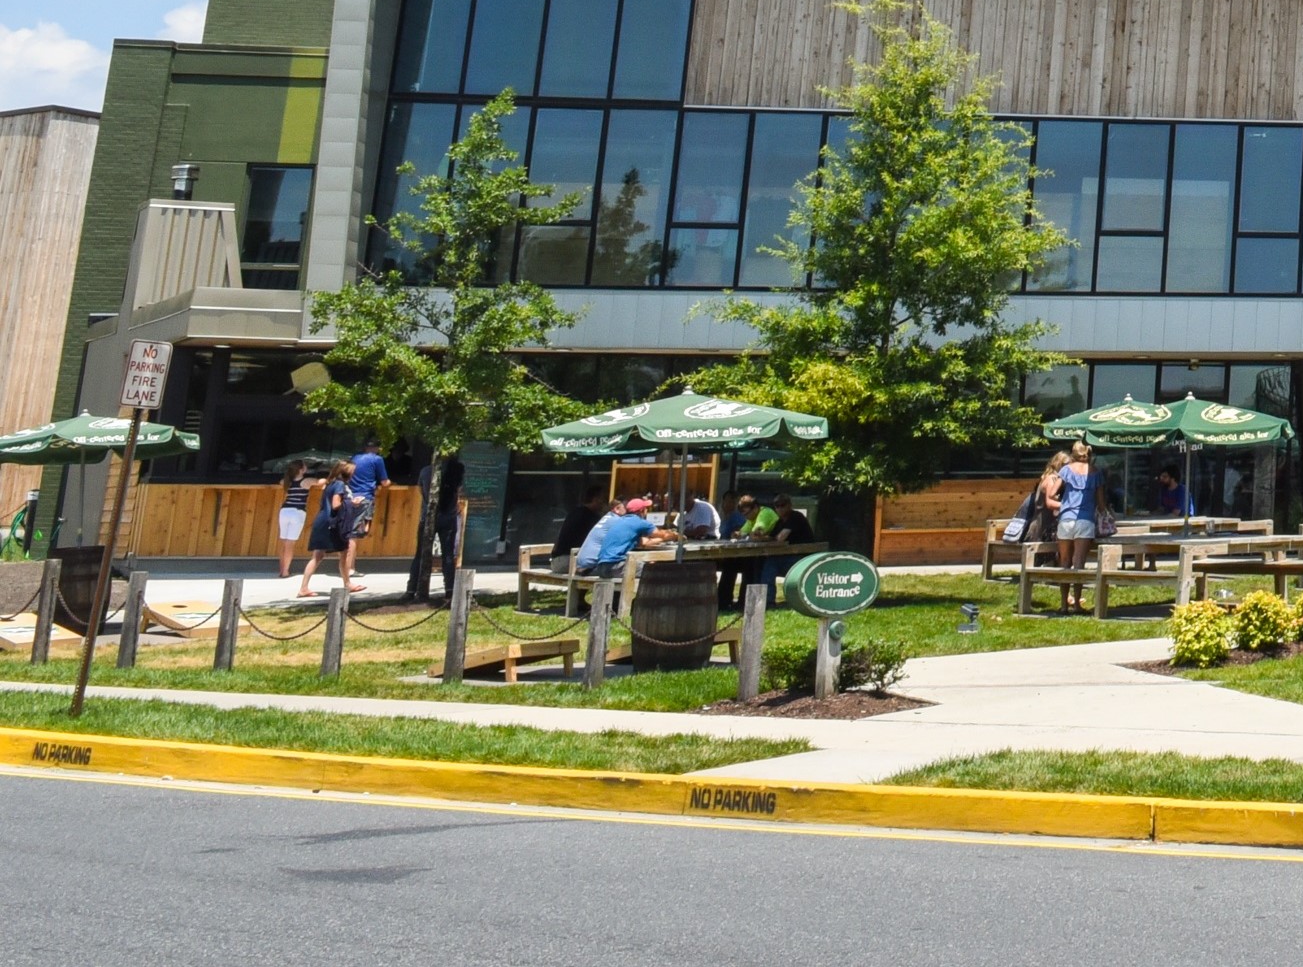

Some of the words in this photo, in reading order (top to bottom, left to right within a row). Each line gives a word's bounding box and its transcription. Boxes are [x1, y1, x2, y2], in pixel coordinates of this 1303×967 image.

[143, 347, 158, 359] NO
[130, 360, 166, 374] PARKING
[132, 375, 157, 387] FIRE
[126, 389, 157, 402] LANE
[148, 433, 160, 441] for
[656, 428, 718, 438] Off-centered
[723, 427, 744, 437] ales
[747, 425, 763, 434] for
[1179, 443, 1203, 453] Had
[817, 572, 850, 584] Visitor
[815, 585, 860, 598] Entrance
[32, 741, 49, 761] NO
[48, 743, 92, 765] PARKING
[690, 787, 712, 809] NO
[713, 789, 777, 815] PARKING
